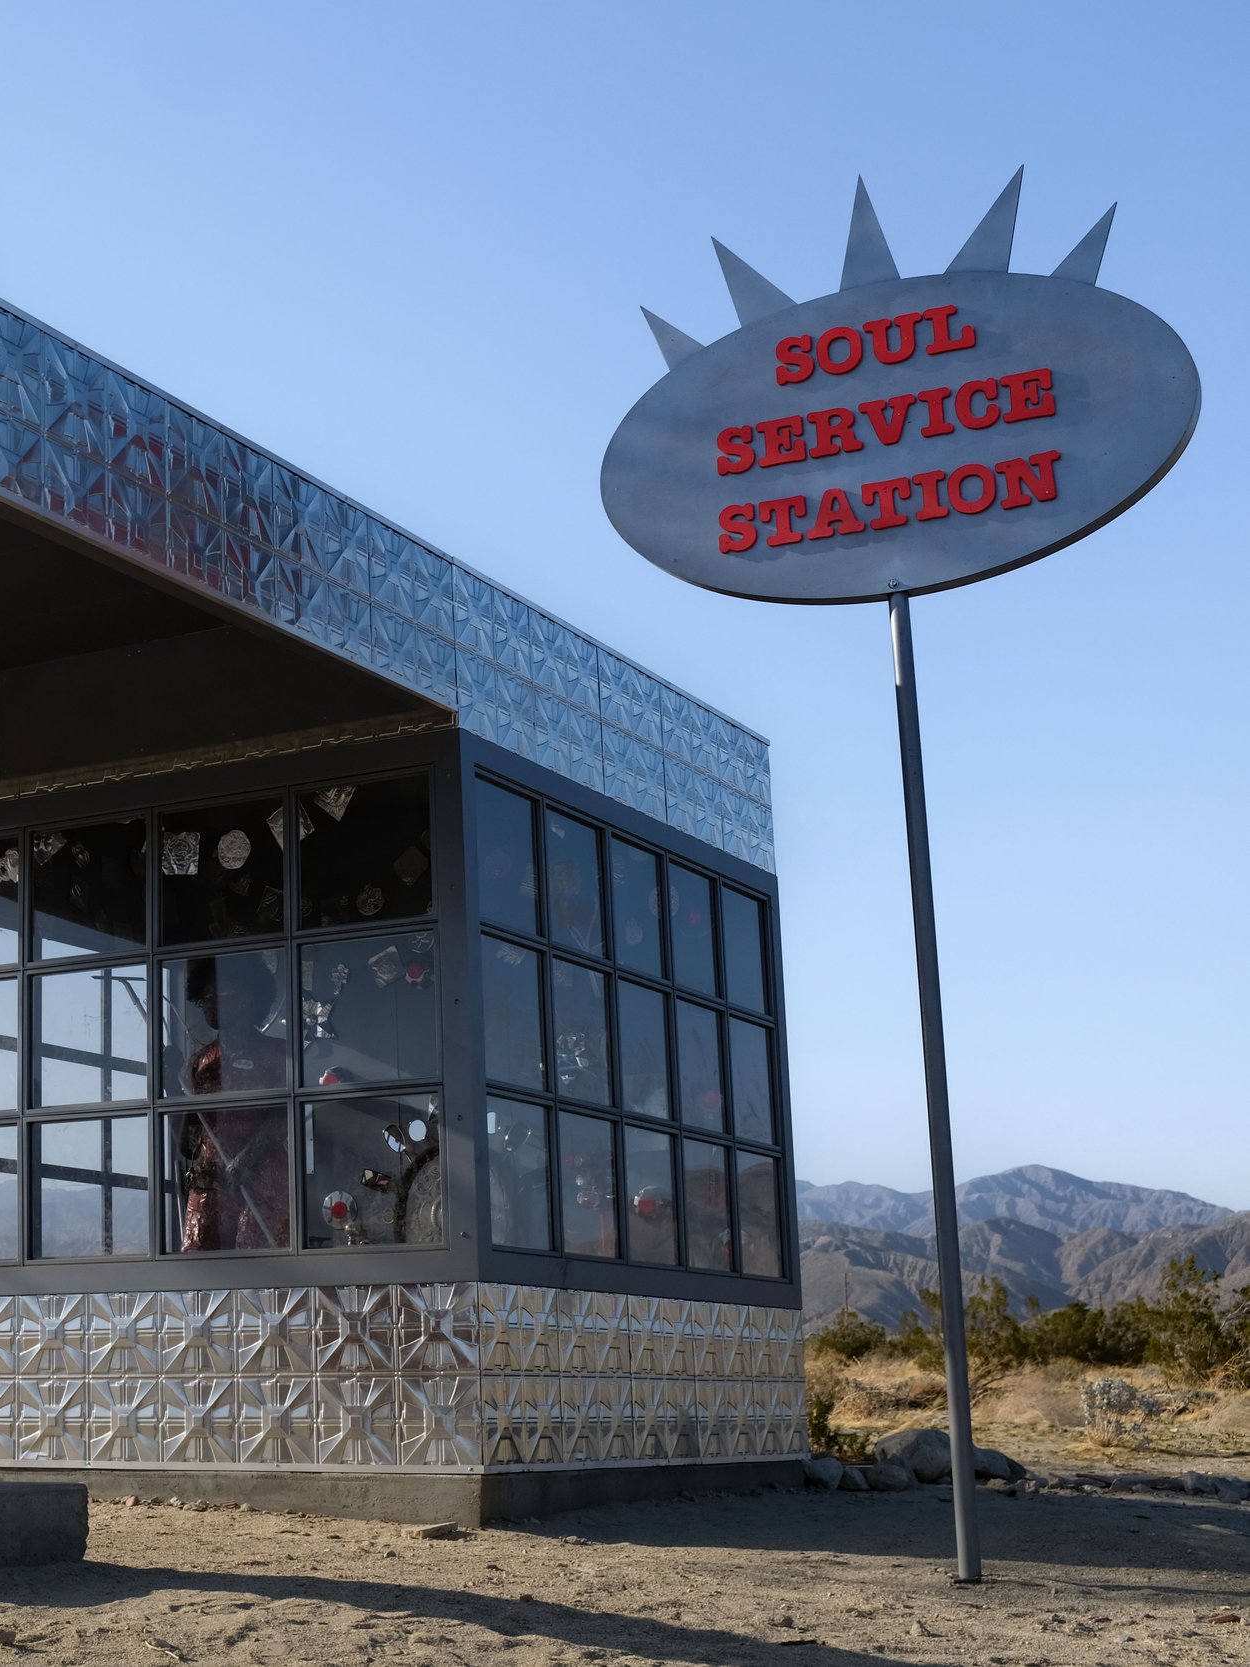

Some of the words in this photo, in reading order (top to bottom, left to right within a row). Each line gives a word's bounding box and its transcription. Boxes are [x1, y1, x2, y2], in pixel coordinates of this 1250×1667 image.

[775, 304, 976, 385] SOUL
[716, 368, 1056, 476] SERVICE
[718, 450, 1060, 554] STATION
